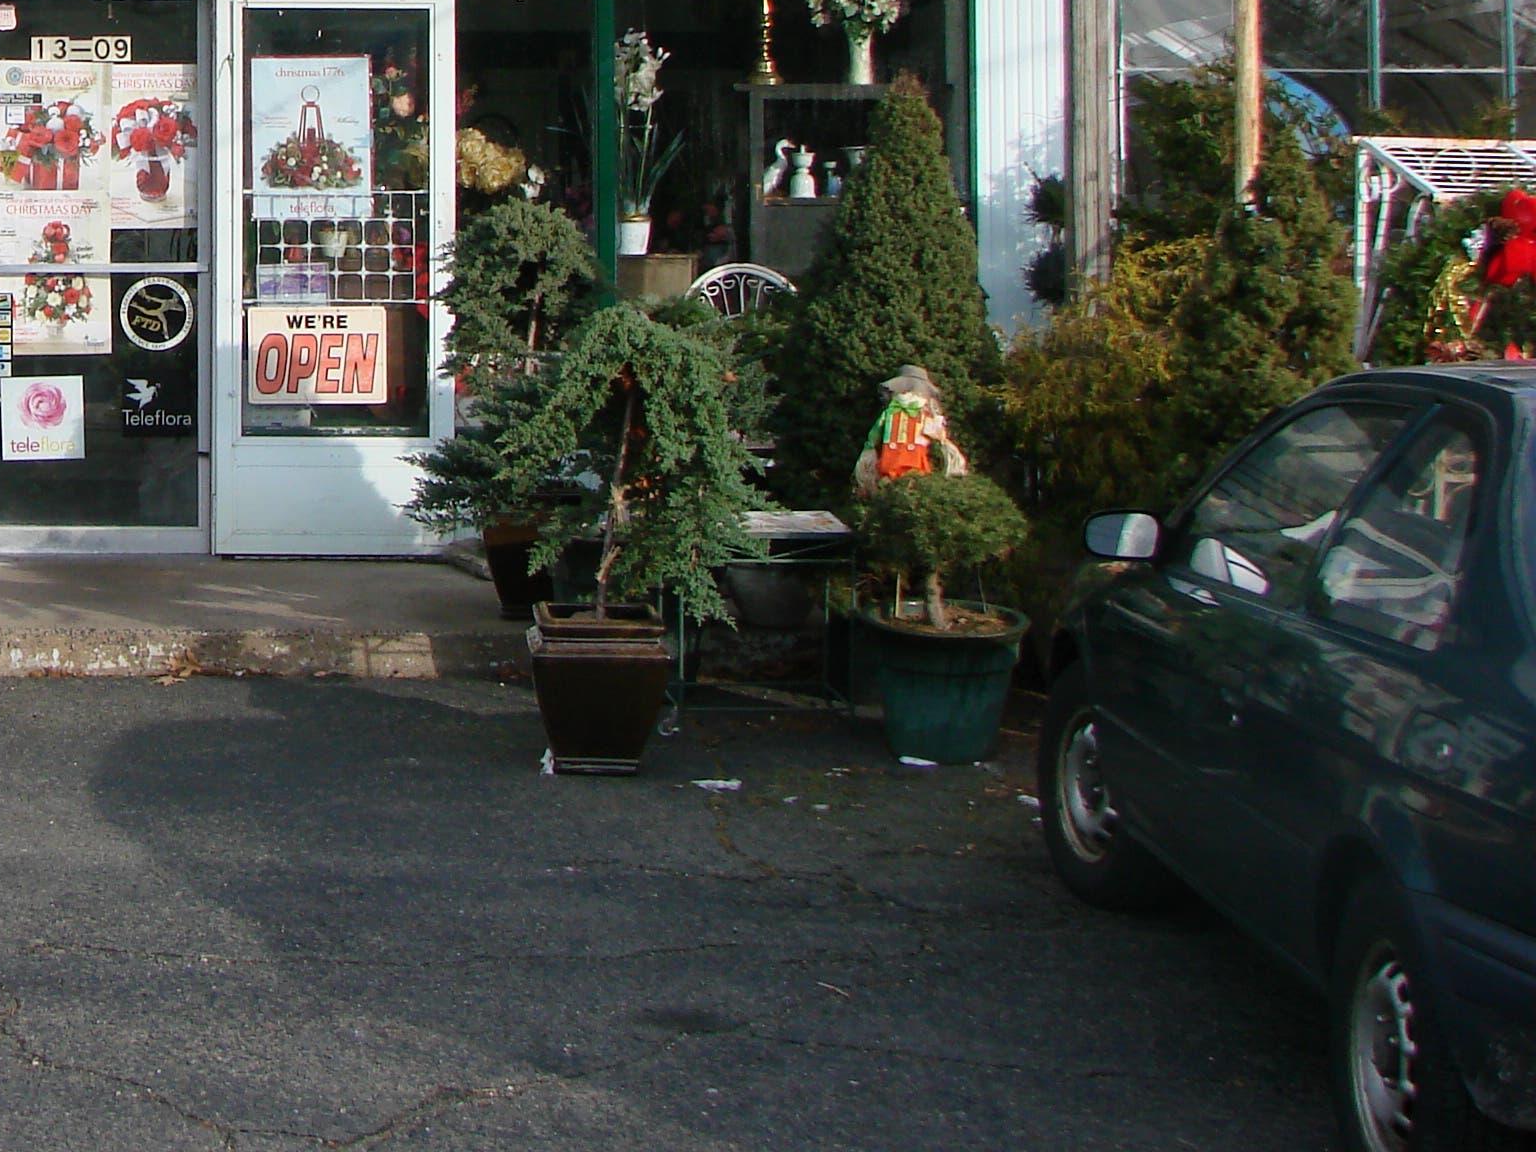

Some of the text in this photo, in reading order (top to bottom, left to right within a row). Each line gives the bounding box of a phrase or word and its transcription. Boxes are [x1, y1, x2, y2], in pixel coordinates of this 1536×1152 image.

[37, 38, 128, 60] 13-09
[275, 67, 320, 77] christmas
[73, 76, 96, 87] DAY
[112, 78, 173, 89] CHRISTMAS
[6, 205, 70, 215] CHRISTMAS
[71, 205, 94, 215] DAY
[131, 315, 161, 332] FTD
[286, 314, 348, 329] WE'RE
[255, 333, 379, 394] OPEN
[122, 409, 192, 426] Teleflora
[10, 435, 76, 453] teleflora
